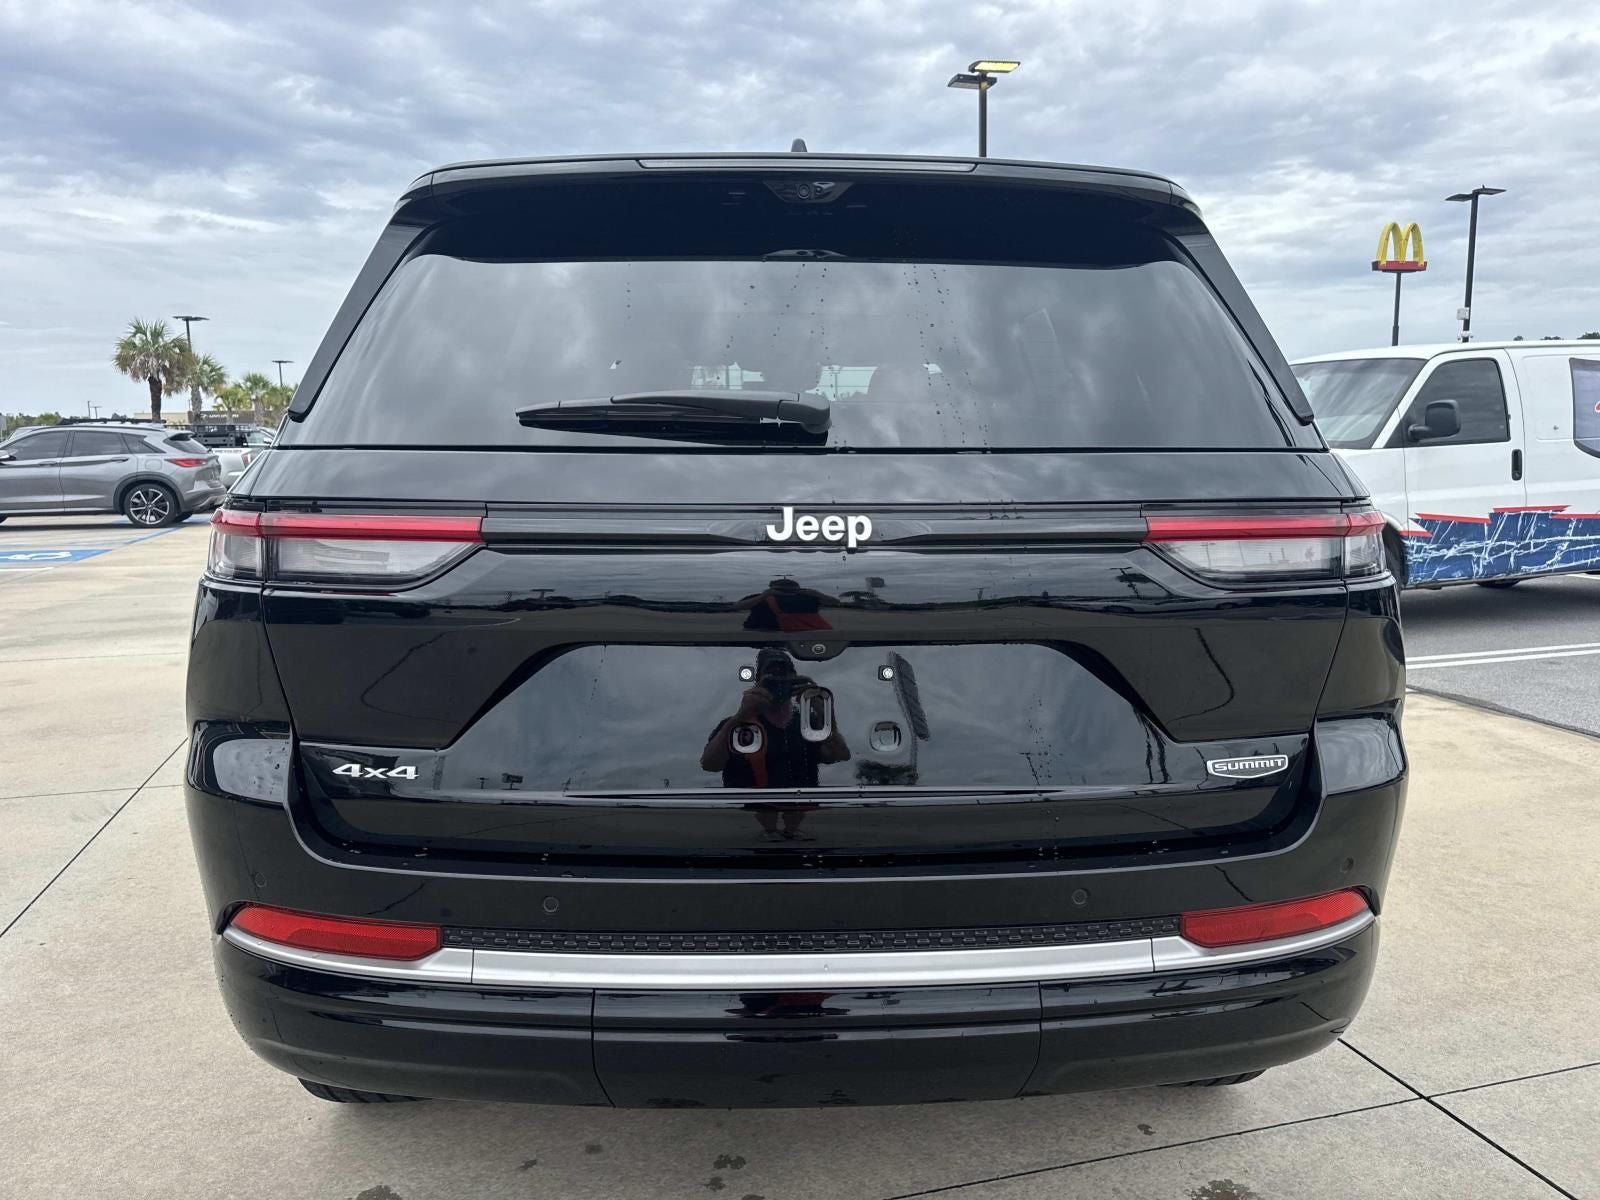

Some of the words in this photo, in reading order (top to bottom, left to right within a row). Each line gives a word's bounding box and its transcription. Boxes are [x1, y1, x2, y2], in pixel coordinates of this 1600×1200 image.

[766, 506, 872, 549] Jeep
[332, 763, 419, 780] 4x4
[1214, 758, 1285, 772] SUMMIT
